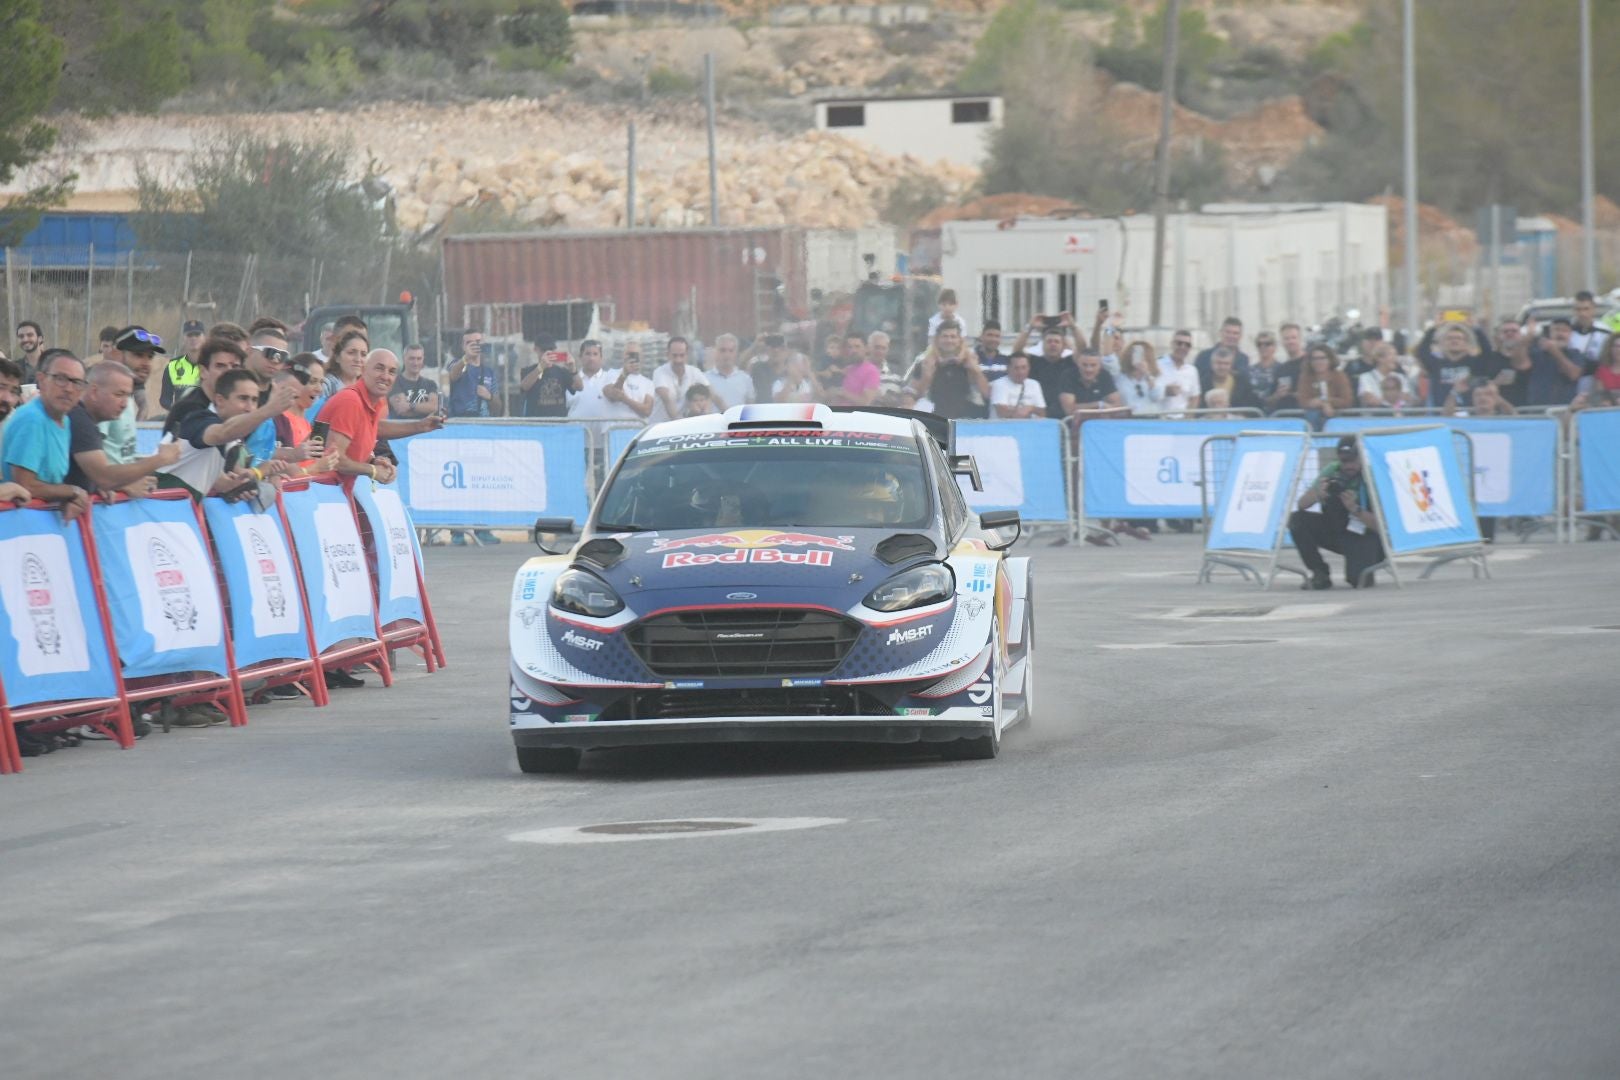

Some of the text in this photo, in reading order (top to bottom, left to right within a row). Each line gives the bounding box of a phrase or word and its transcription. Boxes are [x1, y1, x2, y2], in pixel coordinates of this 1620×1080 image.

[656, 429, 893, 445] FORD PERFORMANCE
[767, 437, 801, 446] ALL
[804, 437, 843, 446] LIVE
[661, 548, 834, 569] Red Bull
